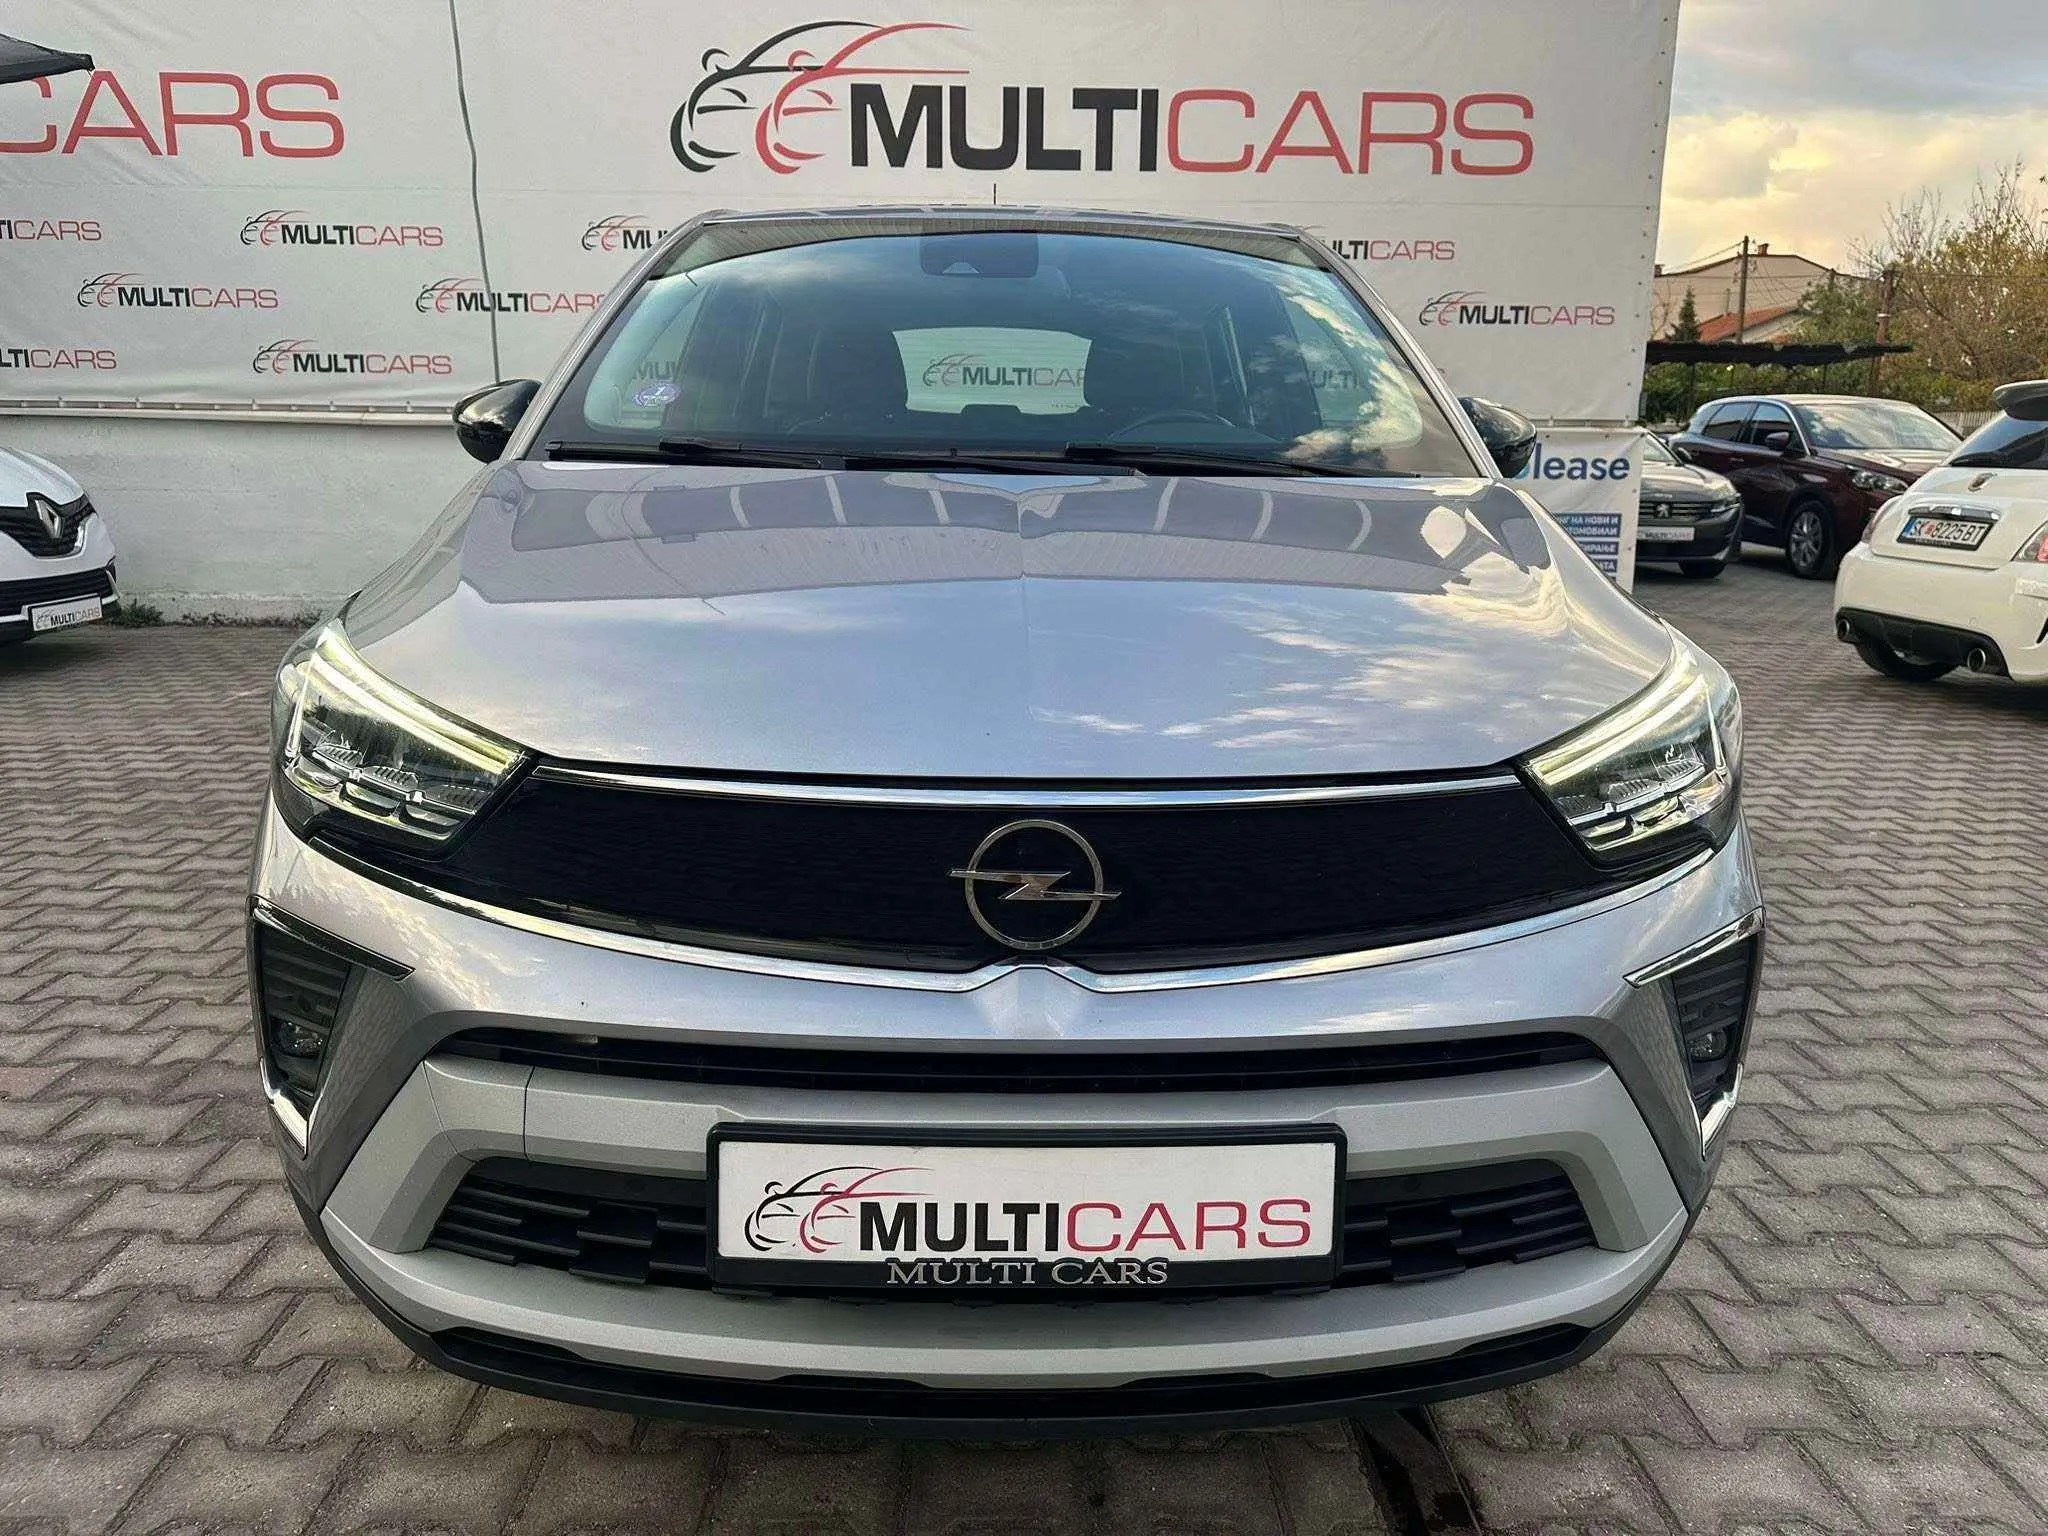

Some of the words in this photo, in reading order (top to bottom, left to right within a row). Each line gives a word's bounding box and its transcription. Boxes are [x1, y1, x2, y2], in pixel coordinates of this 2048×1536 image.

[849, 83, 1534, 176] MULTICARS
[280, 223, 444, 247] MULTICARS
[117, 285, 279, 309] MULTICARS
[1458, 304, 1616, 326] MULTICARS
[292, 352, 453, 375] MULTICARS
[1516, 442, 1631, 480] lease
[859, 1198, 1311, 1253] MULTICARS
[886, 1262, 1036, 1285] MULTI
[1051, 1262, 1169, 1285] CARS
